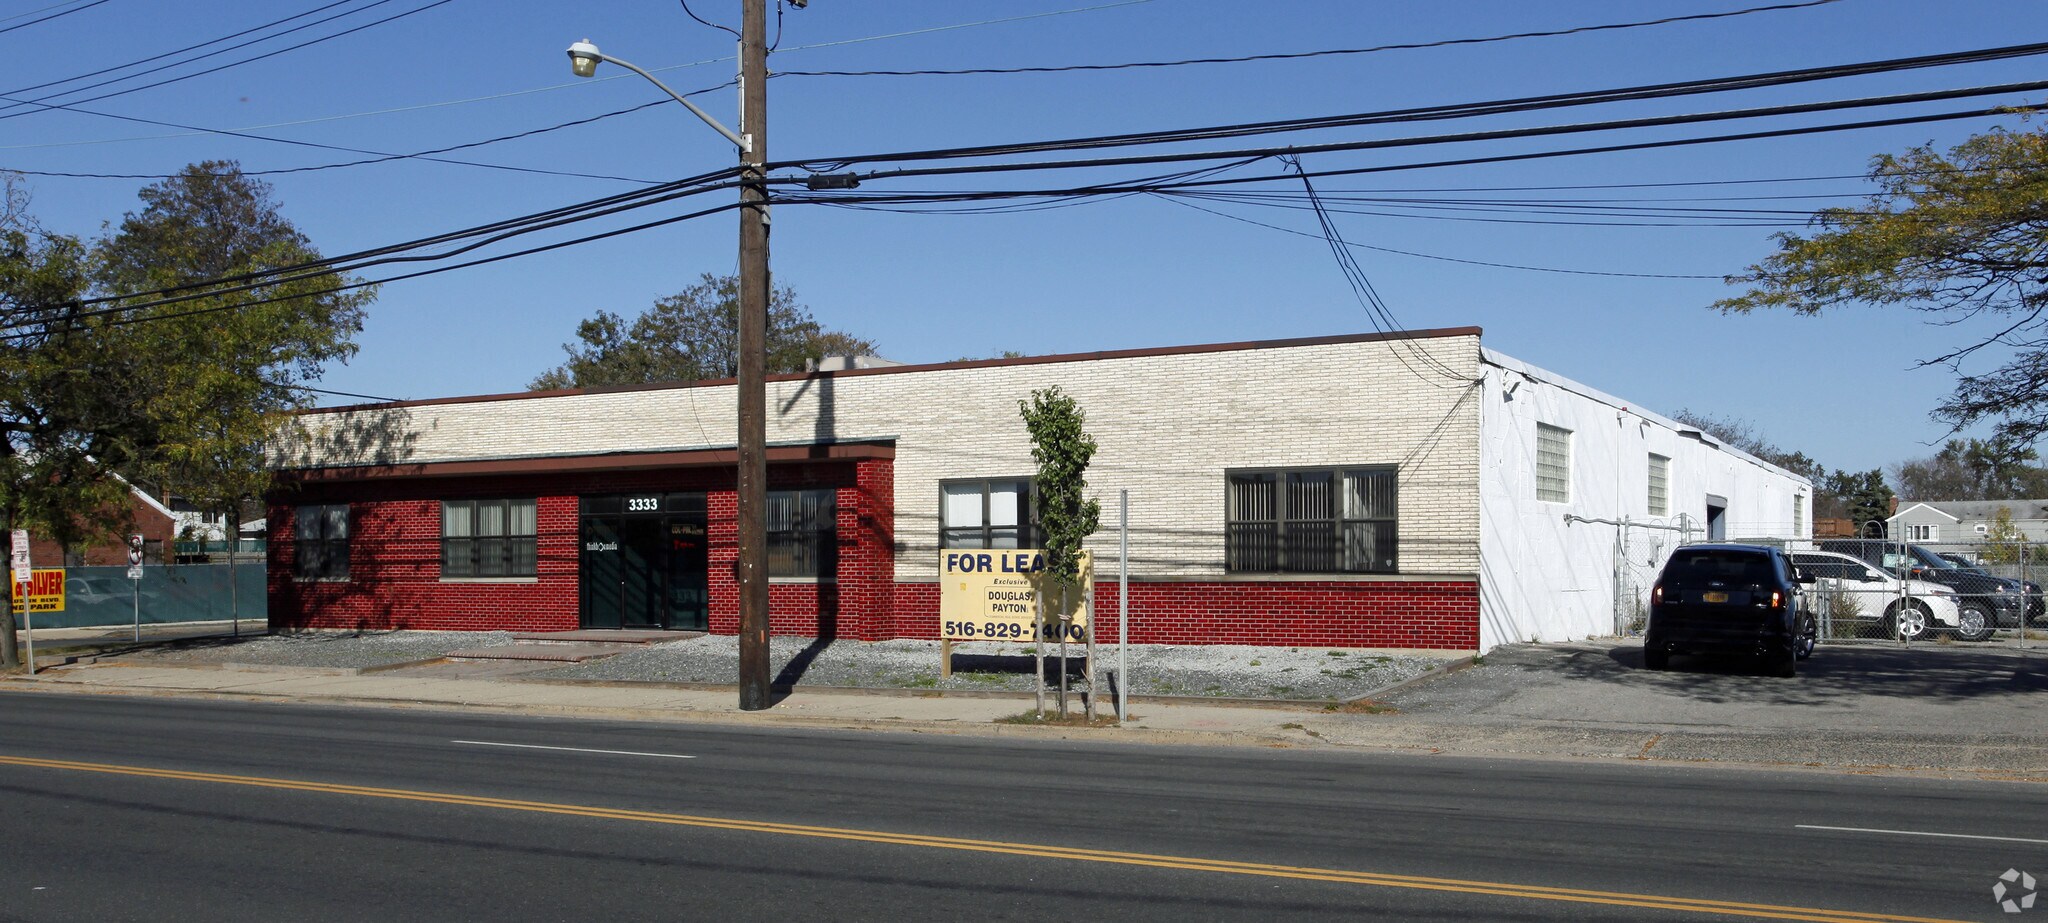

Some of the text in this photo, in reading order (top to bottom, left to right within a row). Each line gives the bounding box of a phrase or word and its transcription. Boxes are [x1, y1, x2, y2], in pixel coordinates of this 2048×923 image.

[628, 498, 658, 511] 3333
[947, 553, 1080, 574] FOR LEA
[993, 578, 1029, 586] Exclusive
[945, 621, 1084, 640] 516-829-7400
